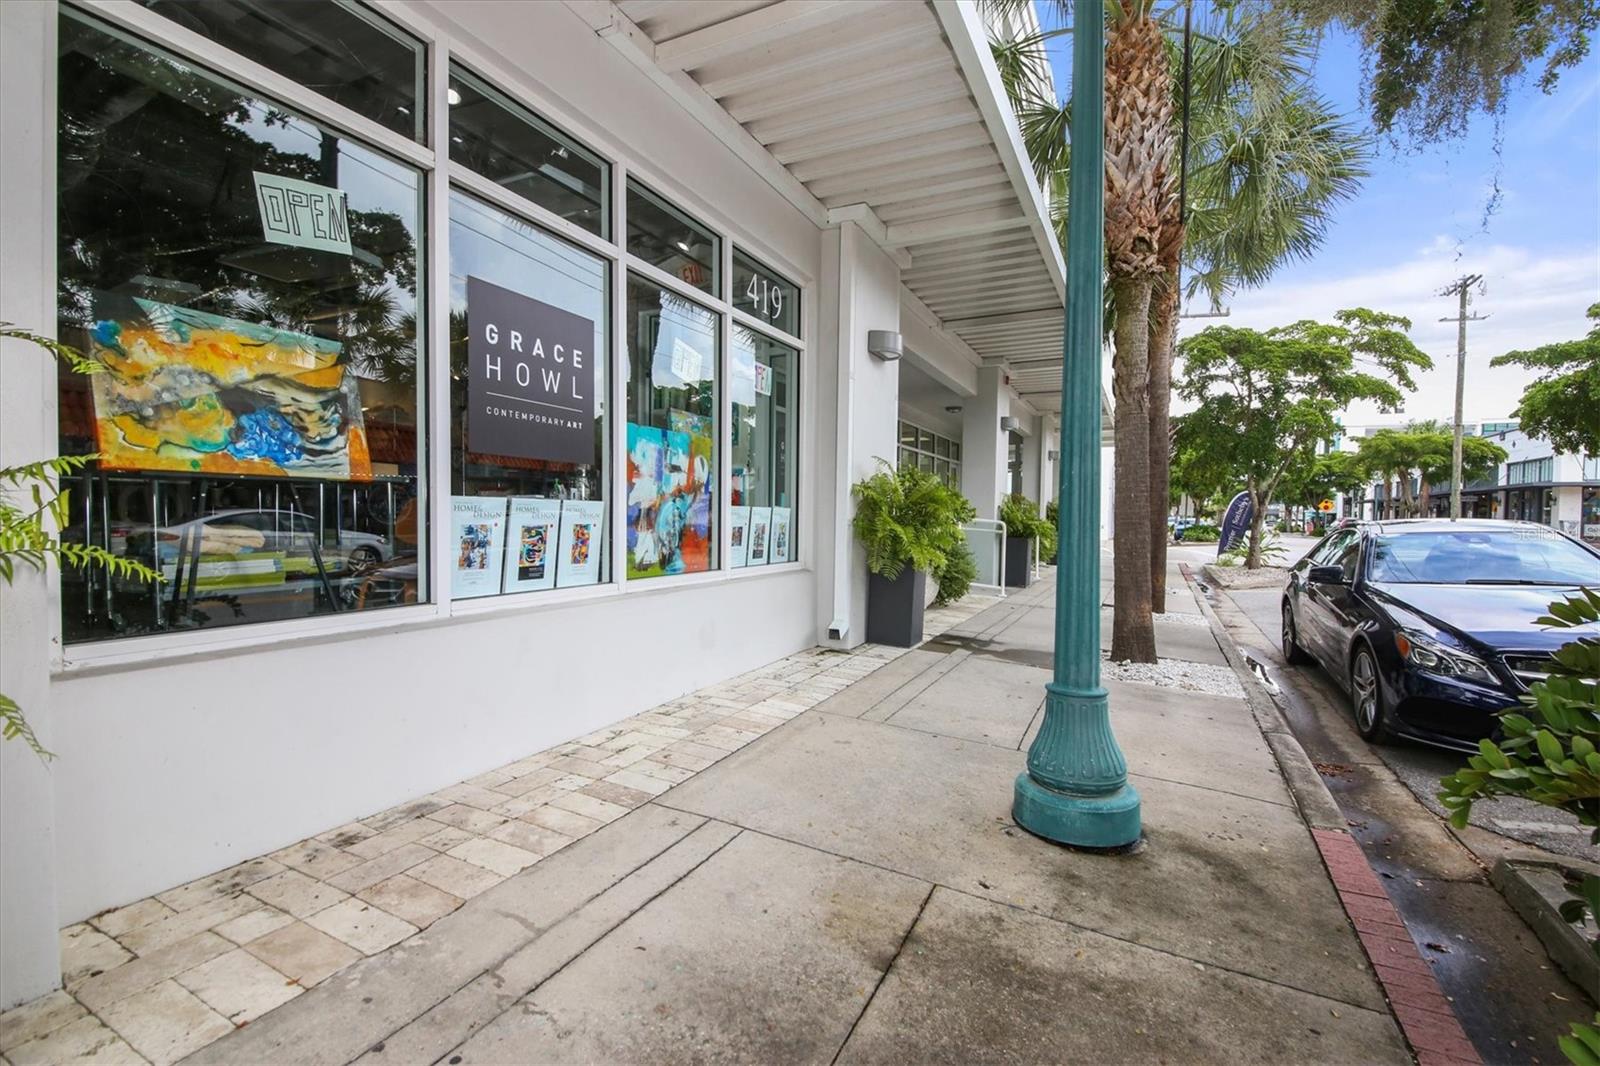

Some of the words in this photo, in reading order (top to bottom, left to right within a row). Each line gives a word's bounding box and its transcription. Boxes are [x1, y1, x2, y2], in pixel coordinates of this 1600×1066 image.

[260, 184, 347, 243] OPEN
[746, 273, 782, 319] 419
[485, 323, 583, 369] GRACE
[486, 353, 583, 399] HOWL
[486, 406, 565, 427] CONTEMPORARY
[566, 420, 583, 430] ART
